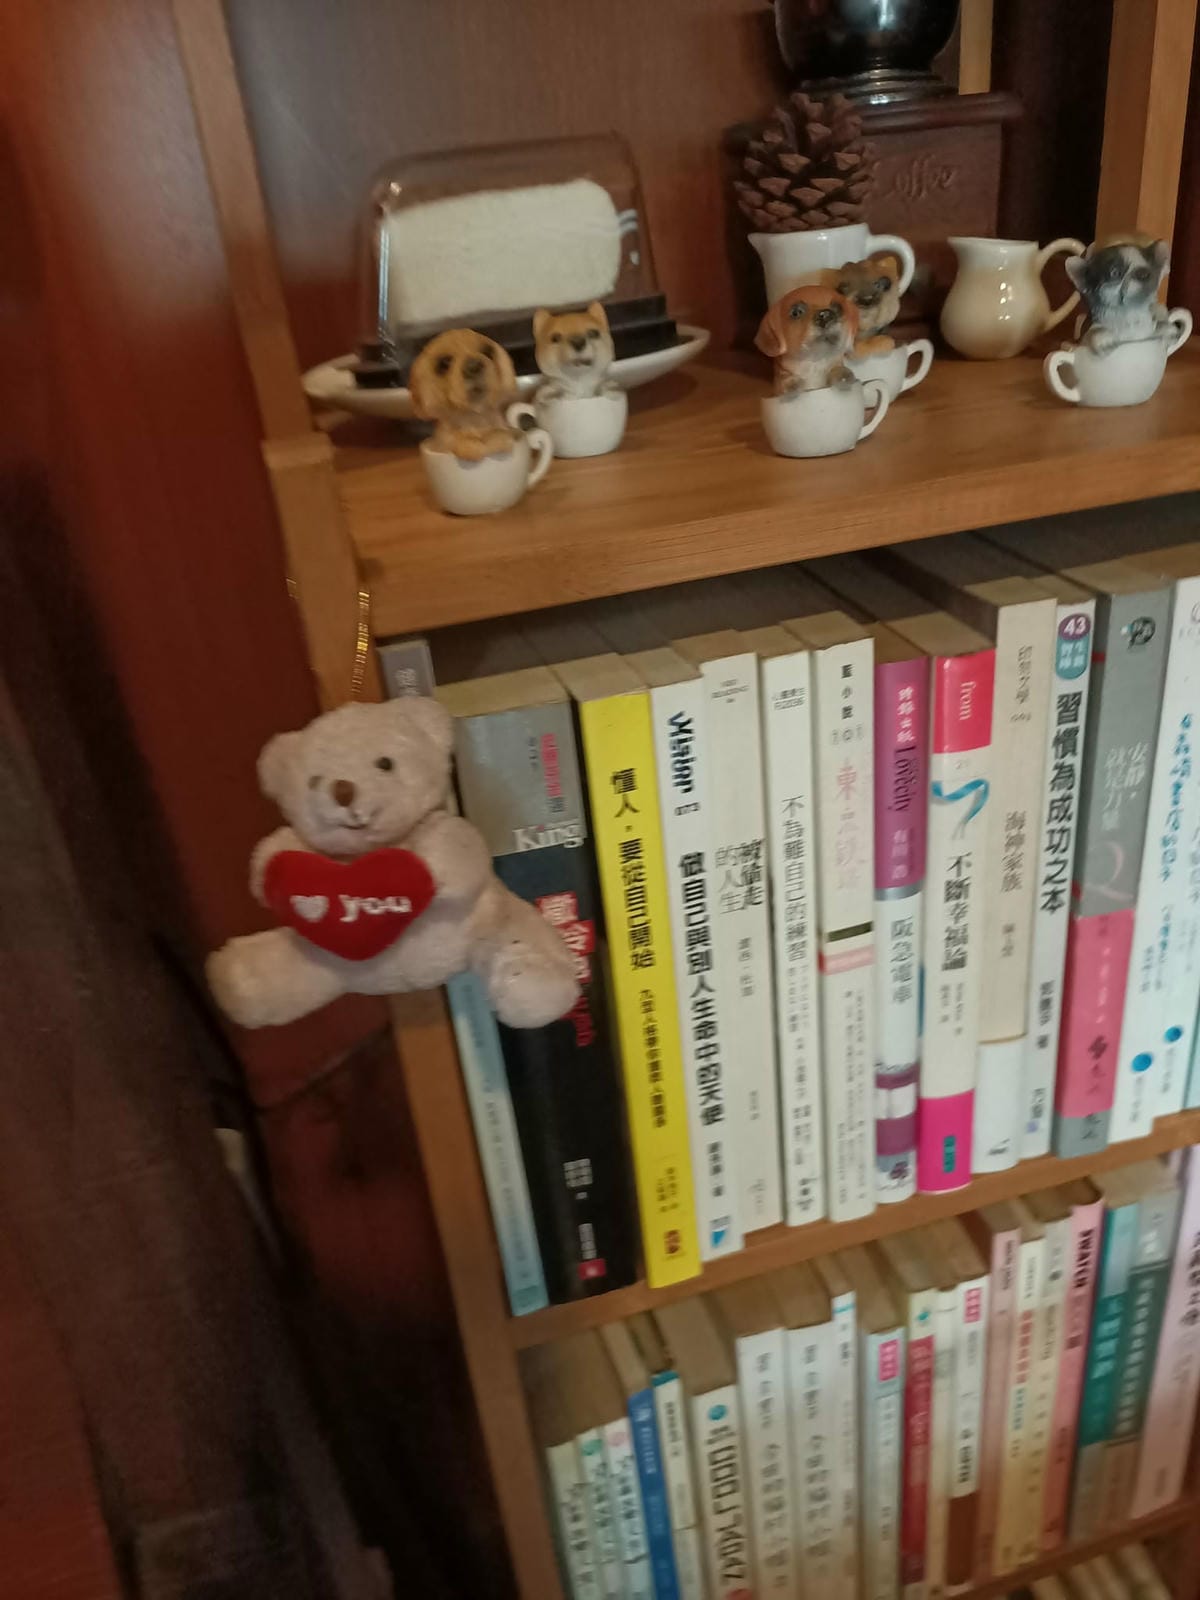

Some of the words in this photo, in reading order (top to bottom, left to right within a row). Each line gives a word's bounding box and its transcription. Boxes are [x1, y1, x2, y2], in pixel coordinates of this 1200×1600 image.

[1063, 616, 1086, 635] 43
[958, 681, 977, 721] from
[1040, 690, 1083, 915] 習慣為成功之本
[512, 818, 585, 852] King
[337, 894, 413, 923] you
